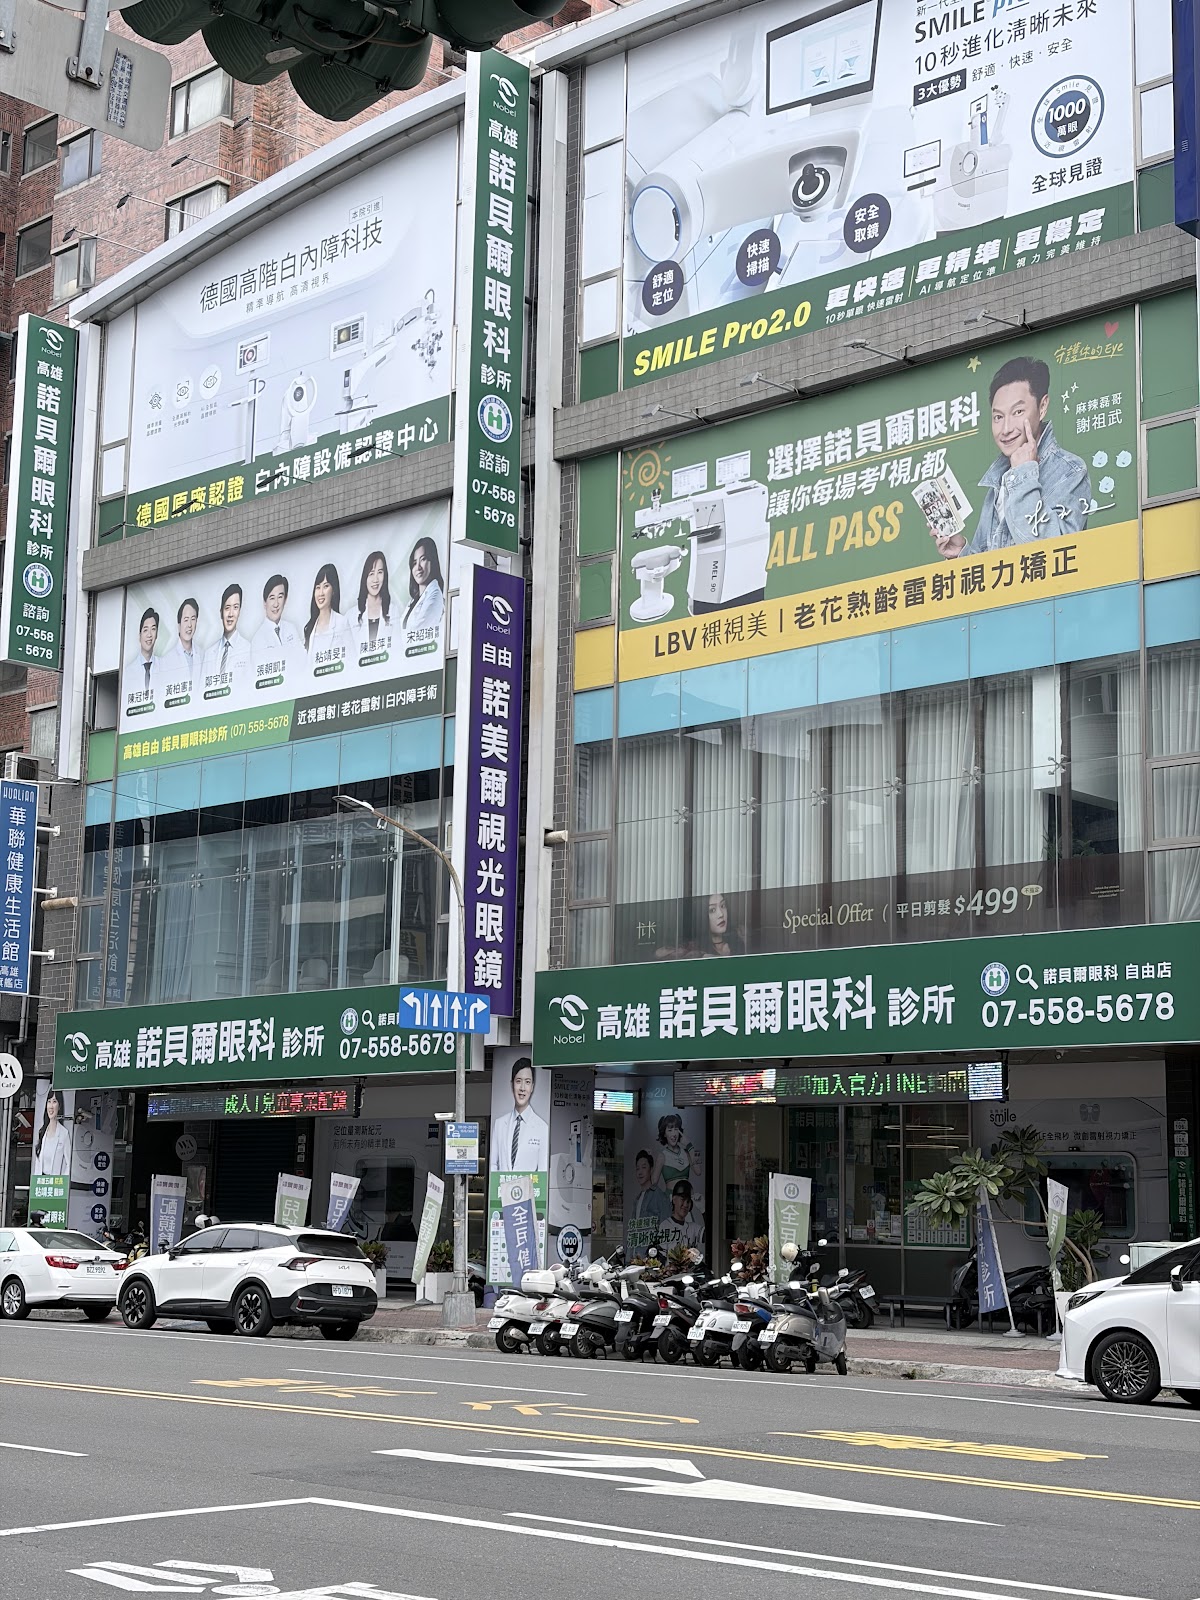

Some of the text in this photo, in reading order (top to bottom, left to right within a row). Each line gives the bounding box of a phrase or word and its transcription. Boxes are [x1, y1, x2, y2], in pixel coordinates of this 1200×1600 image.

[915, 0, 985, 44] SMILE
[915, 0, 1097, 75] 10秒進化清晰未來
[972, 38, 1073, 82] 舒適 快速 安全
[917, 74, 963, 101] 3大優勢
[493, 100, 517, 118] Nobel
[1048, 98, 1086, 123] 1000
[488, 118, 518, 150] 高雄
[1057, 121, 1078, 137] 萬眼
[1032, 156, 1102, 195] 全球見證
[854, 204, 880, 224] 安全
[854, 223, 880, 243] 取鏡
[1013, 207, 1106, 255] 更穩定
[483, 149, 517, 364] 諾貝爾眼科
[746, 238, 770, 259] 快速
[914, 239, 1001, 283] 更精準
[1016, 235, 1102, 269] 視力完美維持
[200, 216, 383, 314] 德國高階白內障科技
[652, 269, 675, 289] 舒適
[746, 260, 770, 278] 掃描
[652, 287, 674, 307] 定位
[825, 265, 907, 312] 更快速
[919, 284, 932, 296] AI
[825, 292, 904, 325] 10秒單眼 快速雷射
[41, 347, 63, 359] Nobel
[633, 300, 812, 377] SMILE Pro2.0
[37, 360, 63, 382] 高雄
[480, 363, 512, 394] 診所
[1075, 391, 1123, 416] 麻辣磊哥
[766, 391, 980, 483] 選擇諾貝爾眼科
[1075, 409, 1123, 435] 謝祖武
[29, 382, 62, 540] 諾貝爾眼科
[254, 415, 440, 496] 白內障設備認證中心
[479, 448, 510, 477] 諮詢
[136, 474, 246, 528] 德國原廠認證
[472, 478, 516, 505] 07-558
[26, 540, 54, 561] 診所
[766, 501, 904, 572] ALL PASS
[711, 560, 719, 580] MEL
[23, 603, 50, 623] 諮詢
[654, 544, 1078, 658] LBV 裸視美 老花熟齡雷射視力矯正
[16, 625, 54, 643] 07-558
[486, 622, 511, 636] Nobel
[482, 642, 512, 669] 自由
[297, 703, 337, 726] 近視雷射
[341, 694, 381, 717] 老花雷射
[123, 714, 289, 761] 高雄自由 諾貝爾眼科診所 (07) 558-5678
[473, 676, 512, 990] 諾美爾視光眼鏡
[1, 805, 27, 962] 華聯健康生活館
[783, 885, 1019, 934] Special Offer 平日剪髮 $499
[0, 964, 19, 977] 高雄
[1043, 961, 1173, 985] 諾貝爾眼科 自由店
[553, 974, 954, 1045] Nobel 高雄 諾貝爾眼科 診所
[981, 991, 1175, 1029] 07-558-5678
[66, 1017, 325, 1073] Nobel 高雄 諾貝爾眼科 診所
[339, 1031, 455, 1060] 07-558-5678
[447, 1124, 456, 1136] P
[990, 1109, 1017, 1123] smile
